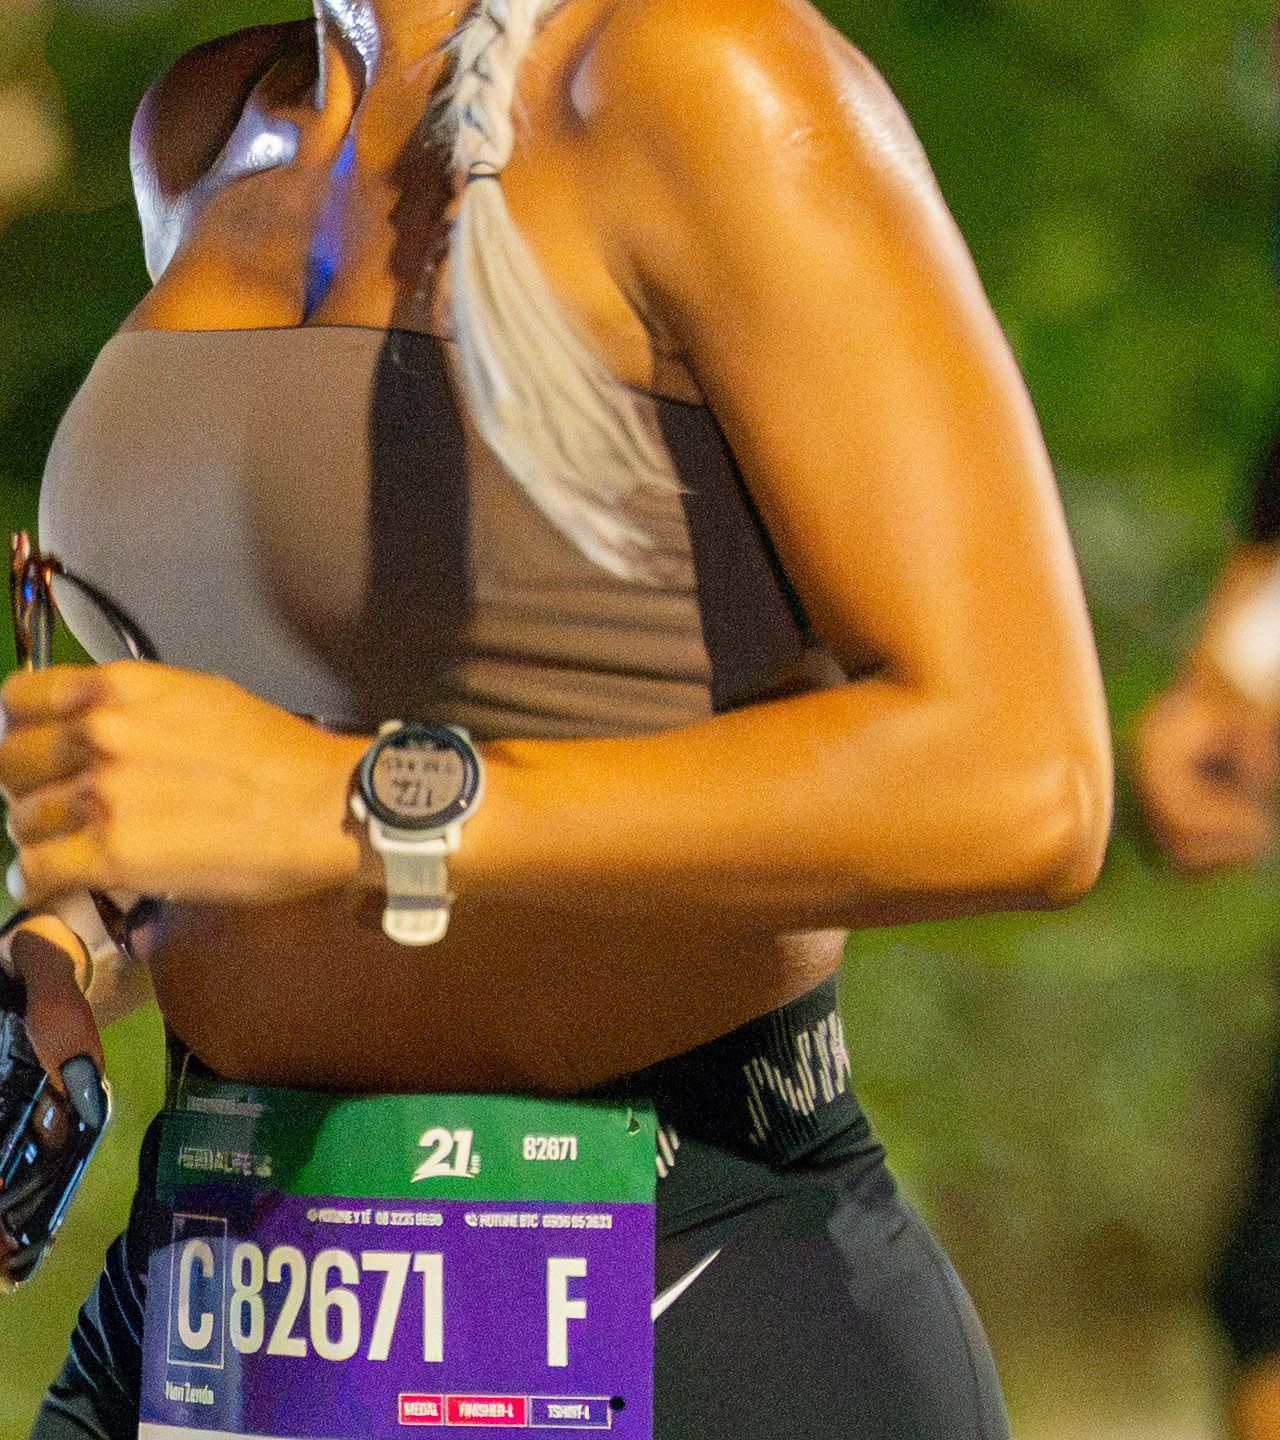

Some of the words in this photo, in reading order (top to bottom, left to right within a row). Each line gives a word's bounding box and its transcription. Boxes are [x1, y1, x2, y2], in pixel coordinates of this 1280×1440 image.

[411, 1126, 475, 1181] 21
[523, 1134, 579, 1162] 82671
[178, 1238, 215, 1351] C
[230, 1243, 445, 1363] 82671
[546, 1257, 588, 1368] F
